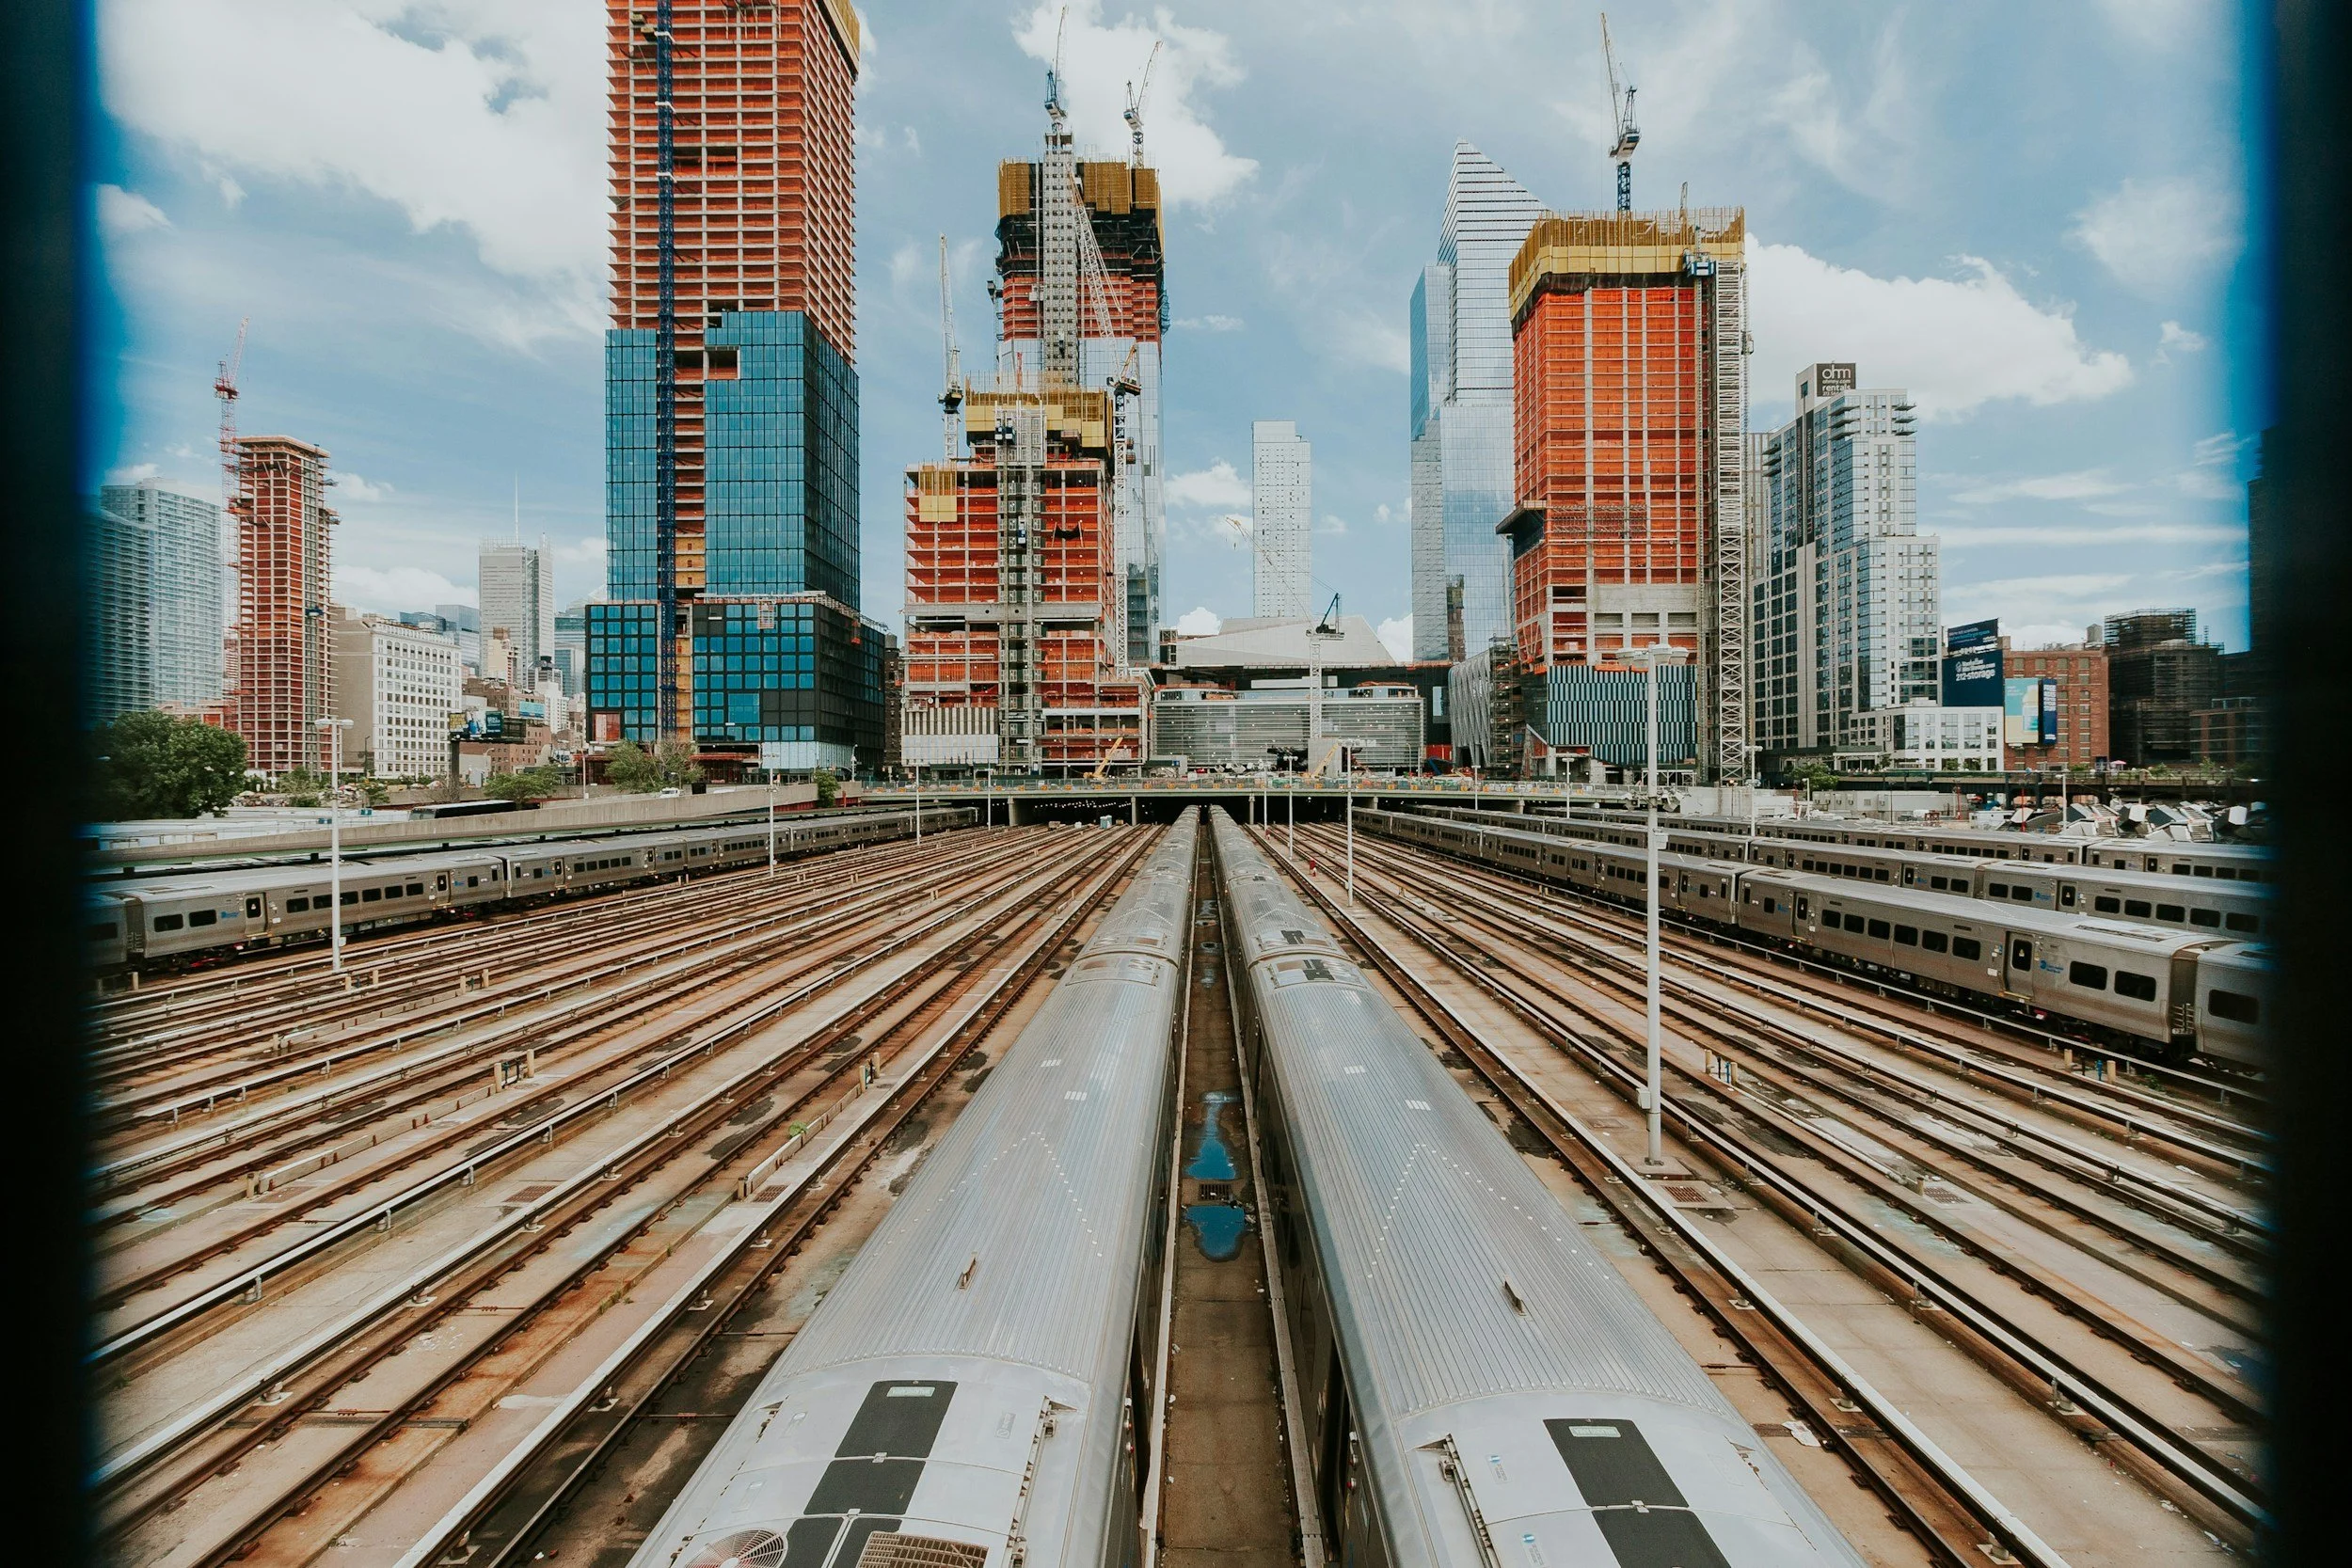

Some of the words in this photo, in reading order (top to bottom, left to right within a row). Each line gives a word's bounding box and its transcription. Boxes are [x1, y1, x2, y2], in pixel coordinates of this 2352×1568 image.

[1821, 364, 1851, 379] ohm
[1821, 384, 1851, 392] rentals
[1806, 456, 1812, 467] no
[1955, 669, 1996, 682] 212-storage
